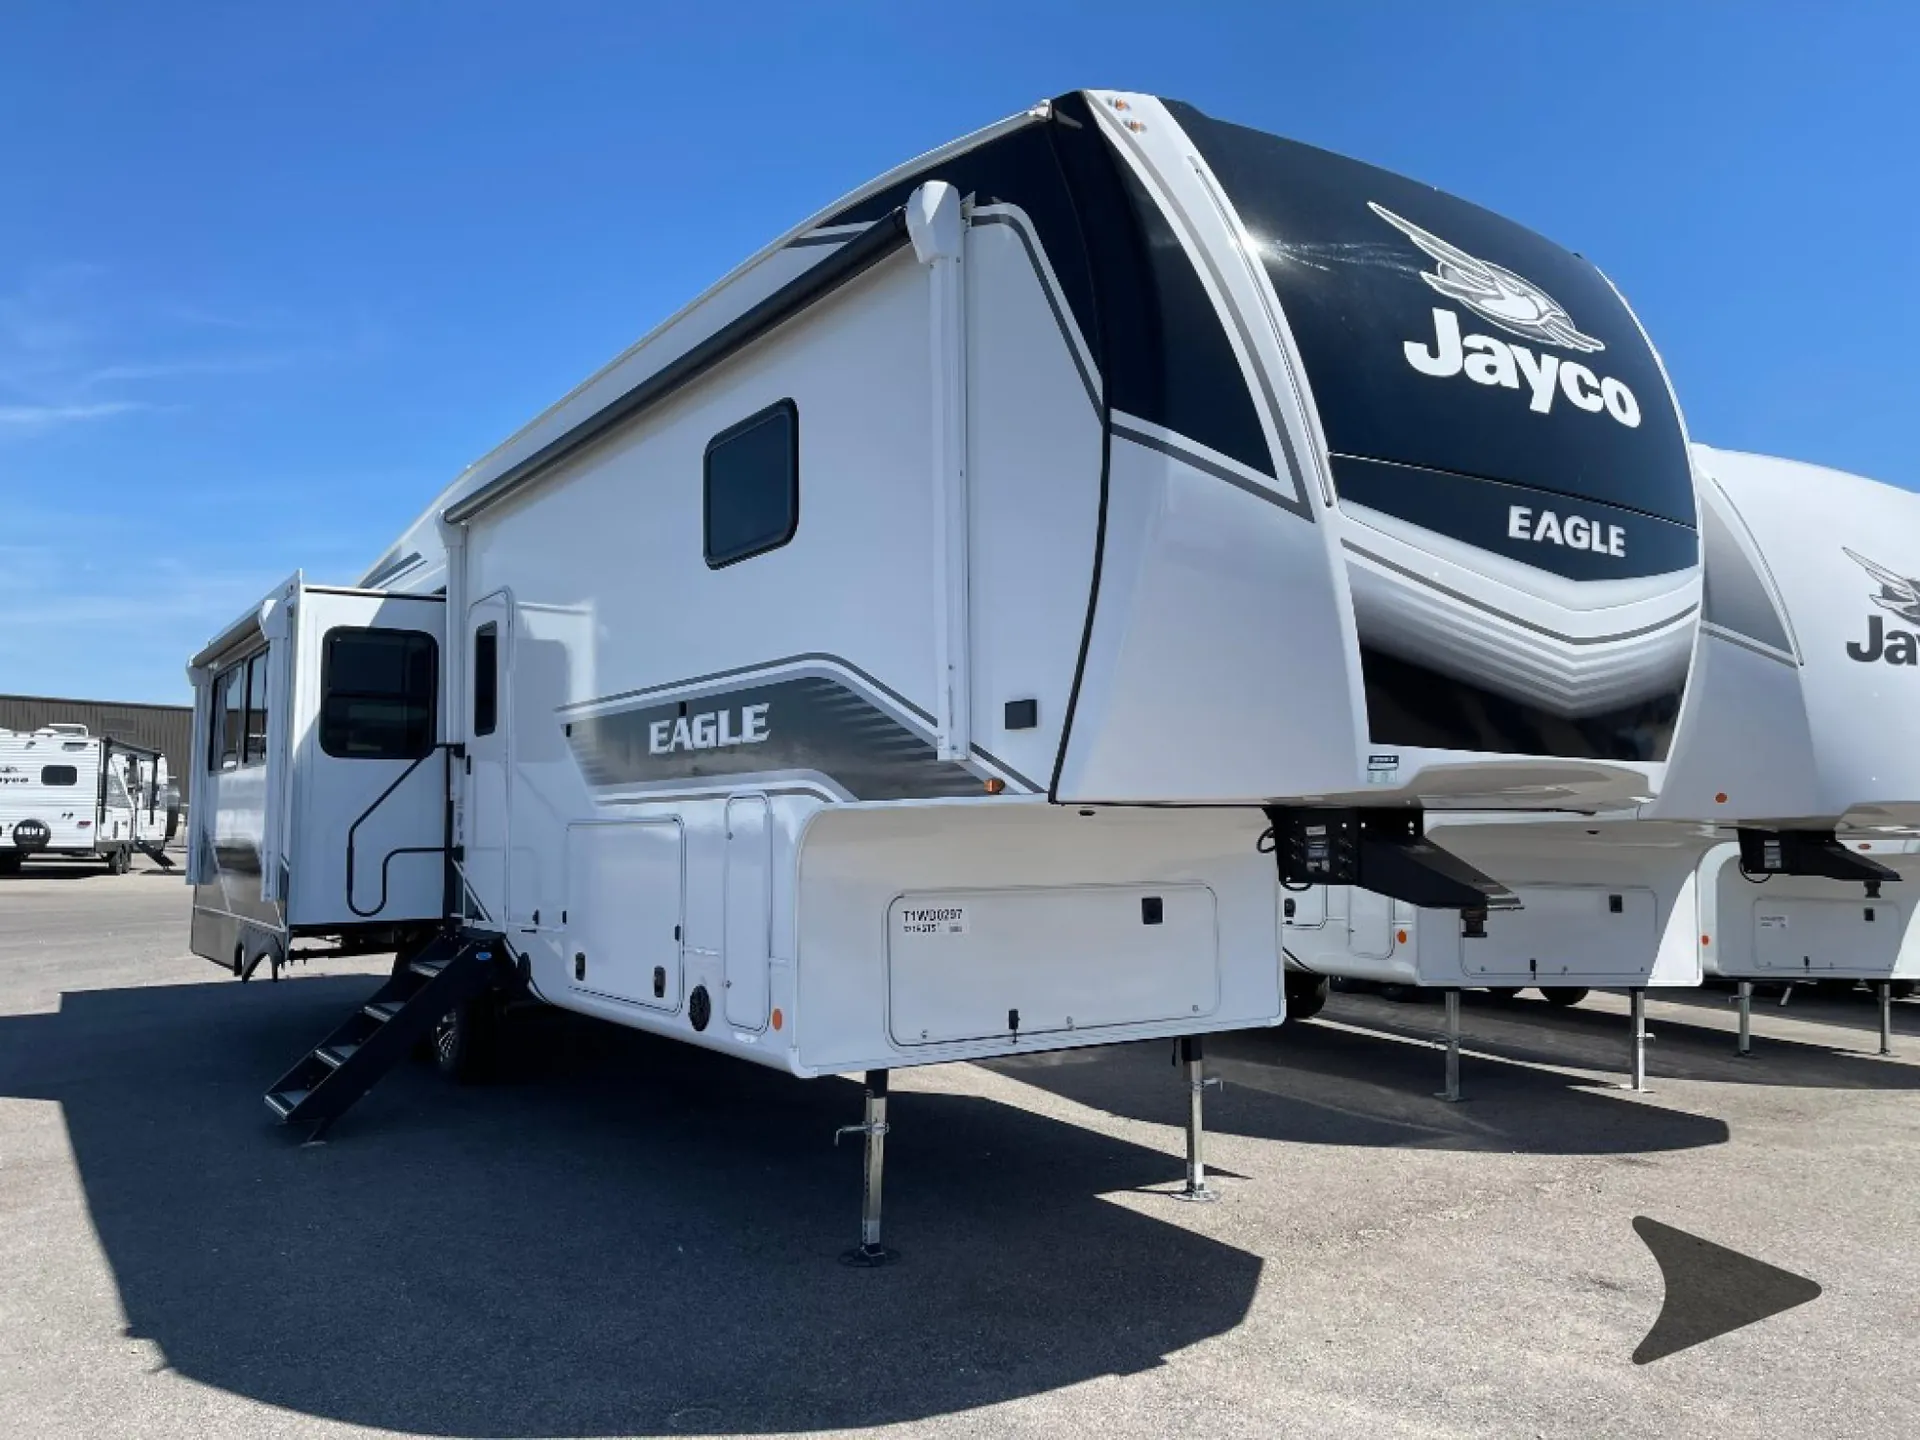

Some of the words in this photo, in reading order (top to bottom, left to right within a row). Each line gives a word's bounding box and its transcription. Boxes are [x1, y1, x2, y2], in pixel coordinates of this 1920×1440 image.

[1404, 307, 1641, 428] Jayco
[1508, 504, 1626, 558] EAGLE
[1846, 615, 1920, 666] Ja
[649, 702, 771, 755] EAGLE
